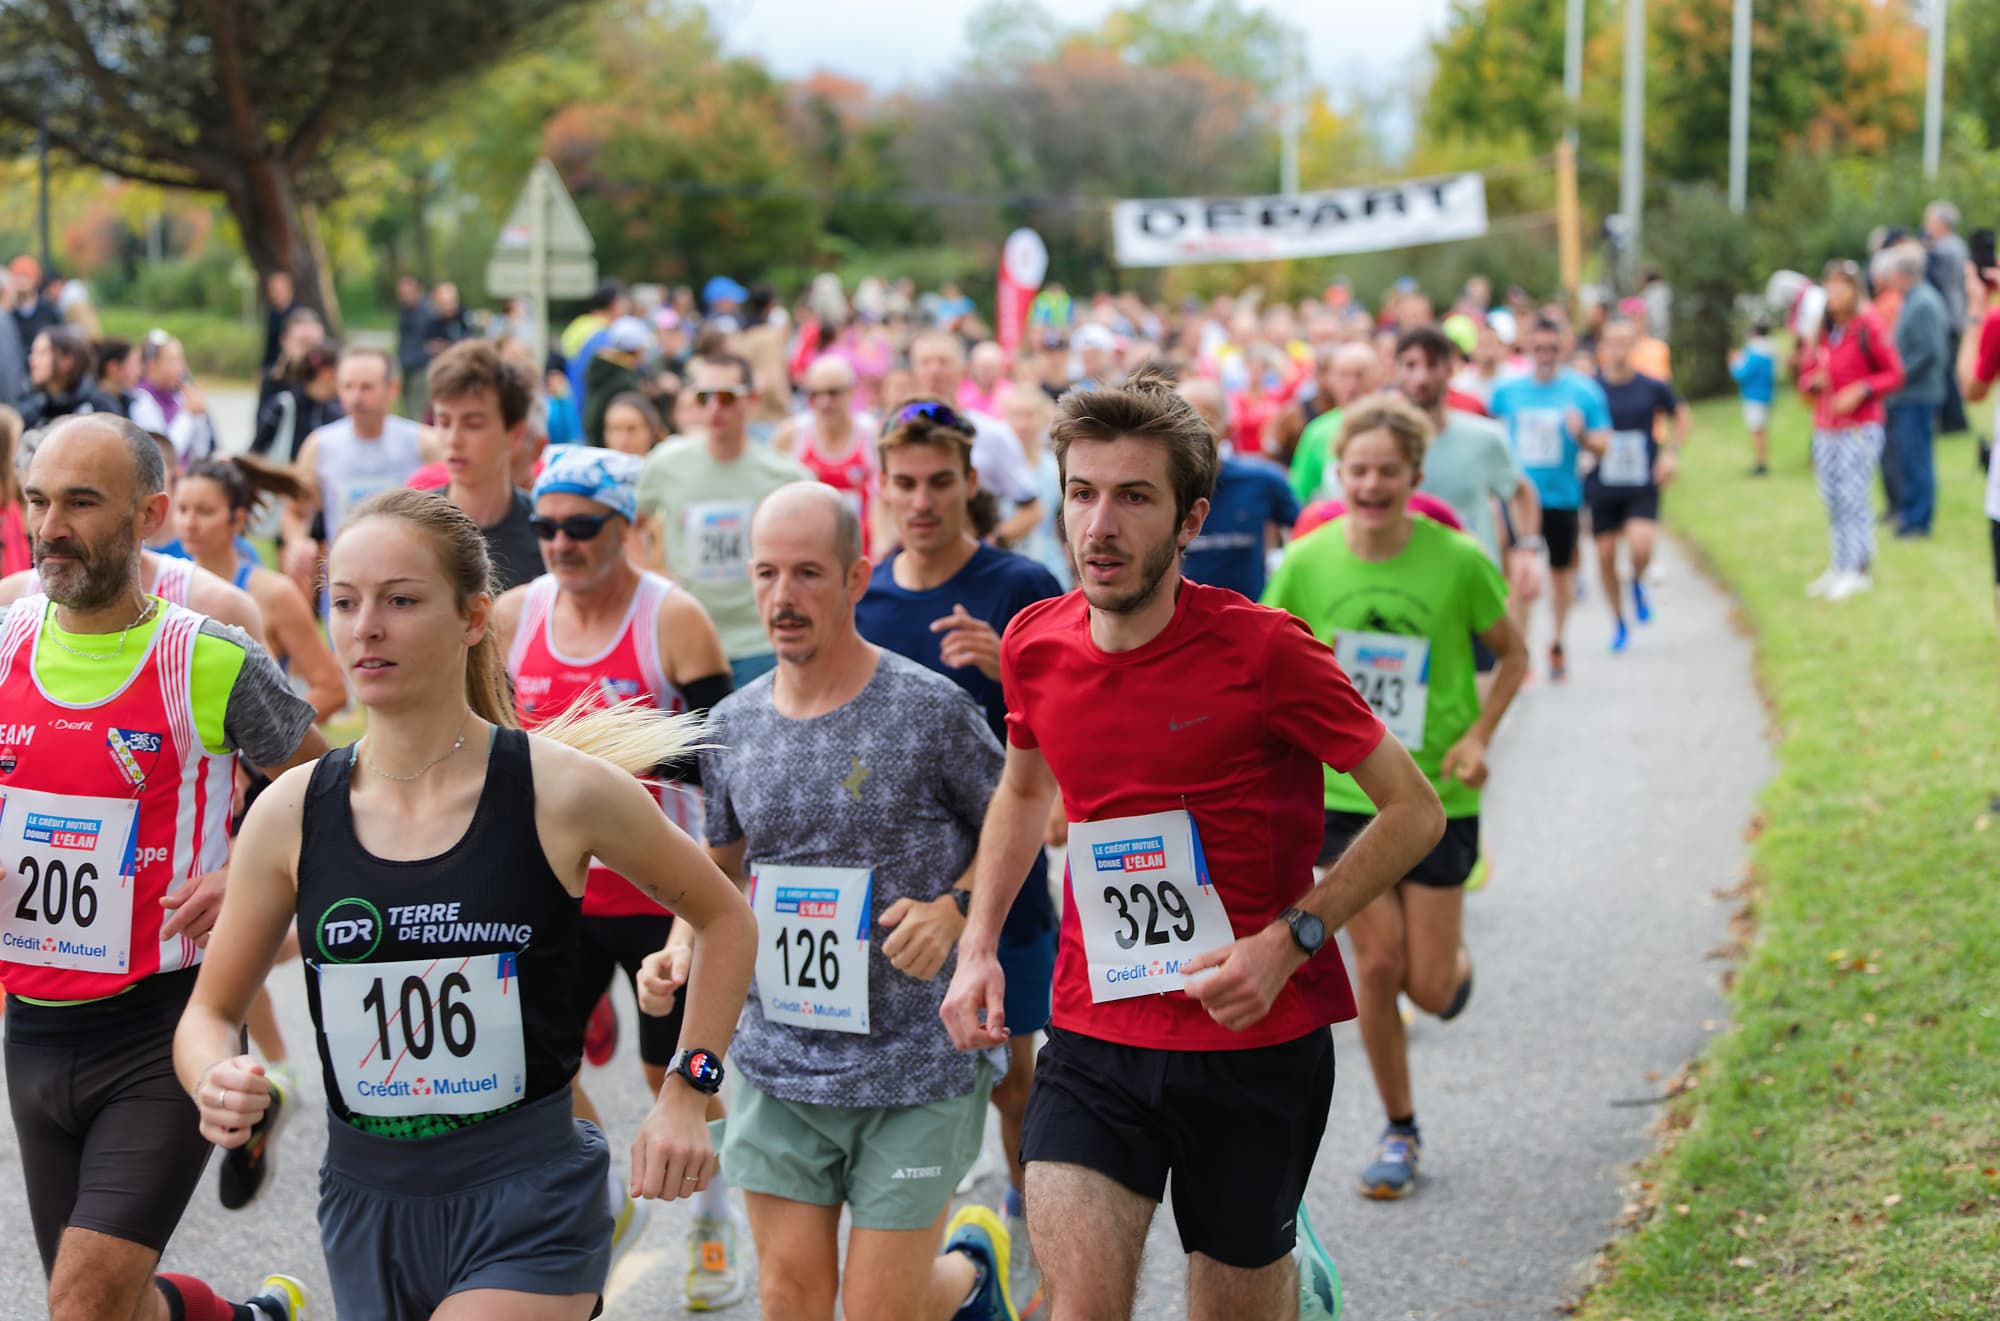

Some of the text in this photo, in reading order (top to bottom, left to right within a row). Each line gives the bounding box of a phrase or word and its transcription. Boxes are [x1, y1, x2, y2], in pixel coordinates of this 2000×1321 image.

[29, 816, 38, 825] LE
[53, 832, 95, 849] L'ÉLAN
[1094, 846, 1104, 855] LE
[1125, 854, 1163, 870] L'ÉLAN
[15, 856, 98, 928] 206
[388, 902, 461, 926] TERRE
[1103, 880, 1195, 950] 329
[324, 918, 374, 946] TDR
[398, 922, 533, 944] DE RUNNING
[3, 932, 106, 958] Crédit Mutuel
[776, 926, 840, 990] 126
[1106, 964, 1147, 983] Crédit
[362, 972, 477, 1061] 106
[357, 1073, 498, 1097] Crédit Mutuel
